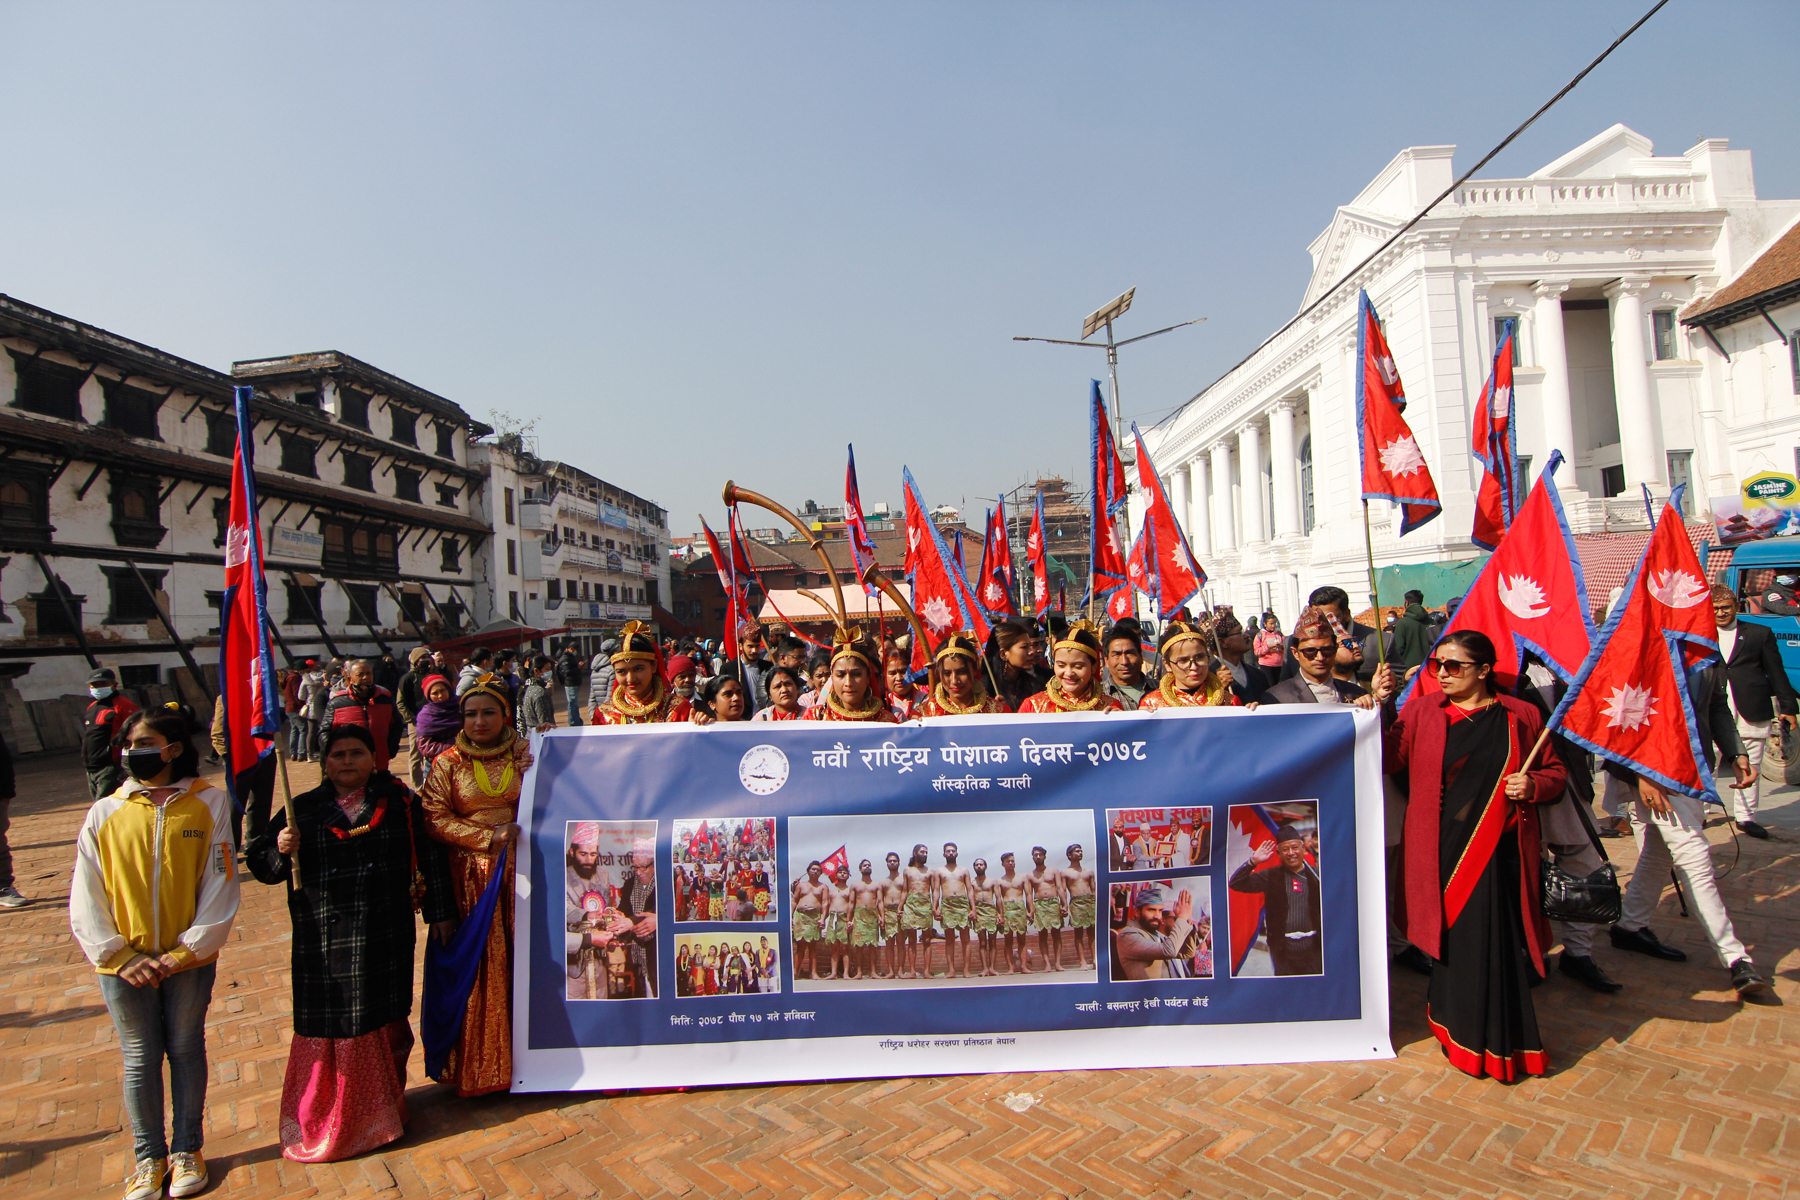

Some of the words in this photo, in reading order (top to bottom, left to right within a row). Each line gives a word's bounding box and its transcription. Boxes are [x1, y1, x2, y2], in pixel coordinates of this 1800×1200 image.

[1753, 482, 1787, 491] JASMINE
[812, 742, 851, 768] नवौं
[859, 741, 931, 774] राष्ट्रिय
[940, 742, 1010, 767] पोशाक
[1019, 737, 1147, 766] दिवस-२०७८
[932, 773, 991, 794] साँस्कृतिक
[1164, 997, 1189, 1007] पर्यटन
[698, 1015, 723, 1027] २०७८
[750, 1014, 762, 1023] १७
[767, 1010, 780, 1022] गते
[784, 1009, 816, 1021] शनिवार
[907, 1039, 930, 1049] धरोहर
[996, 1037, 1016, 1046] नेपाल
